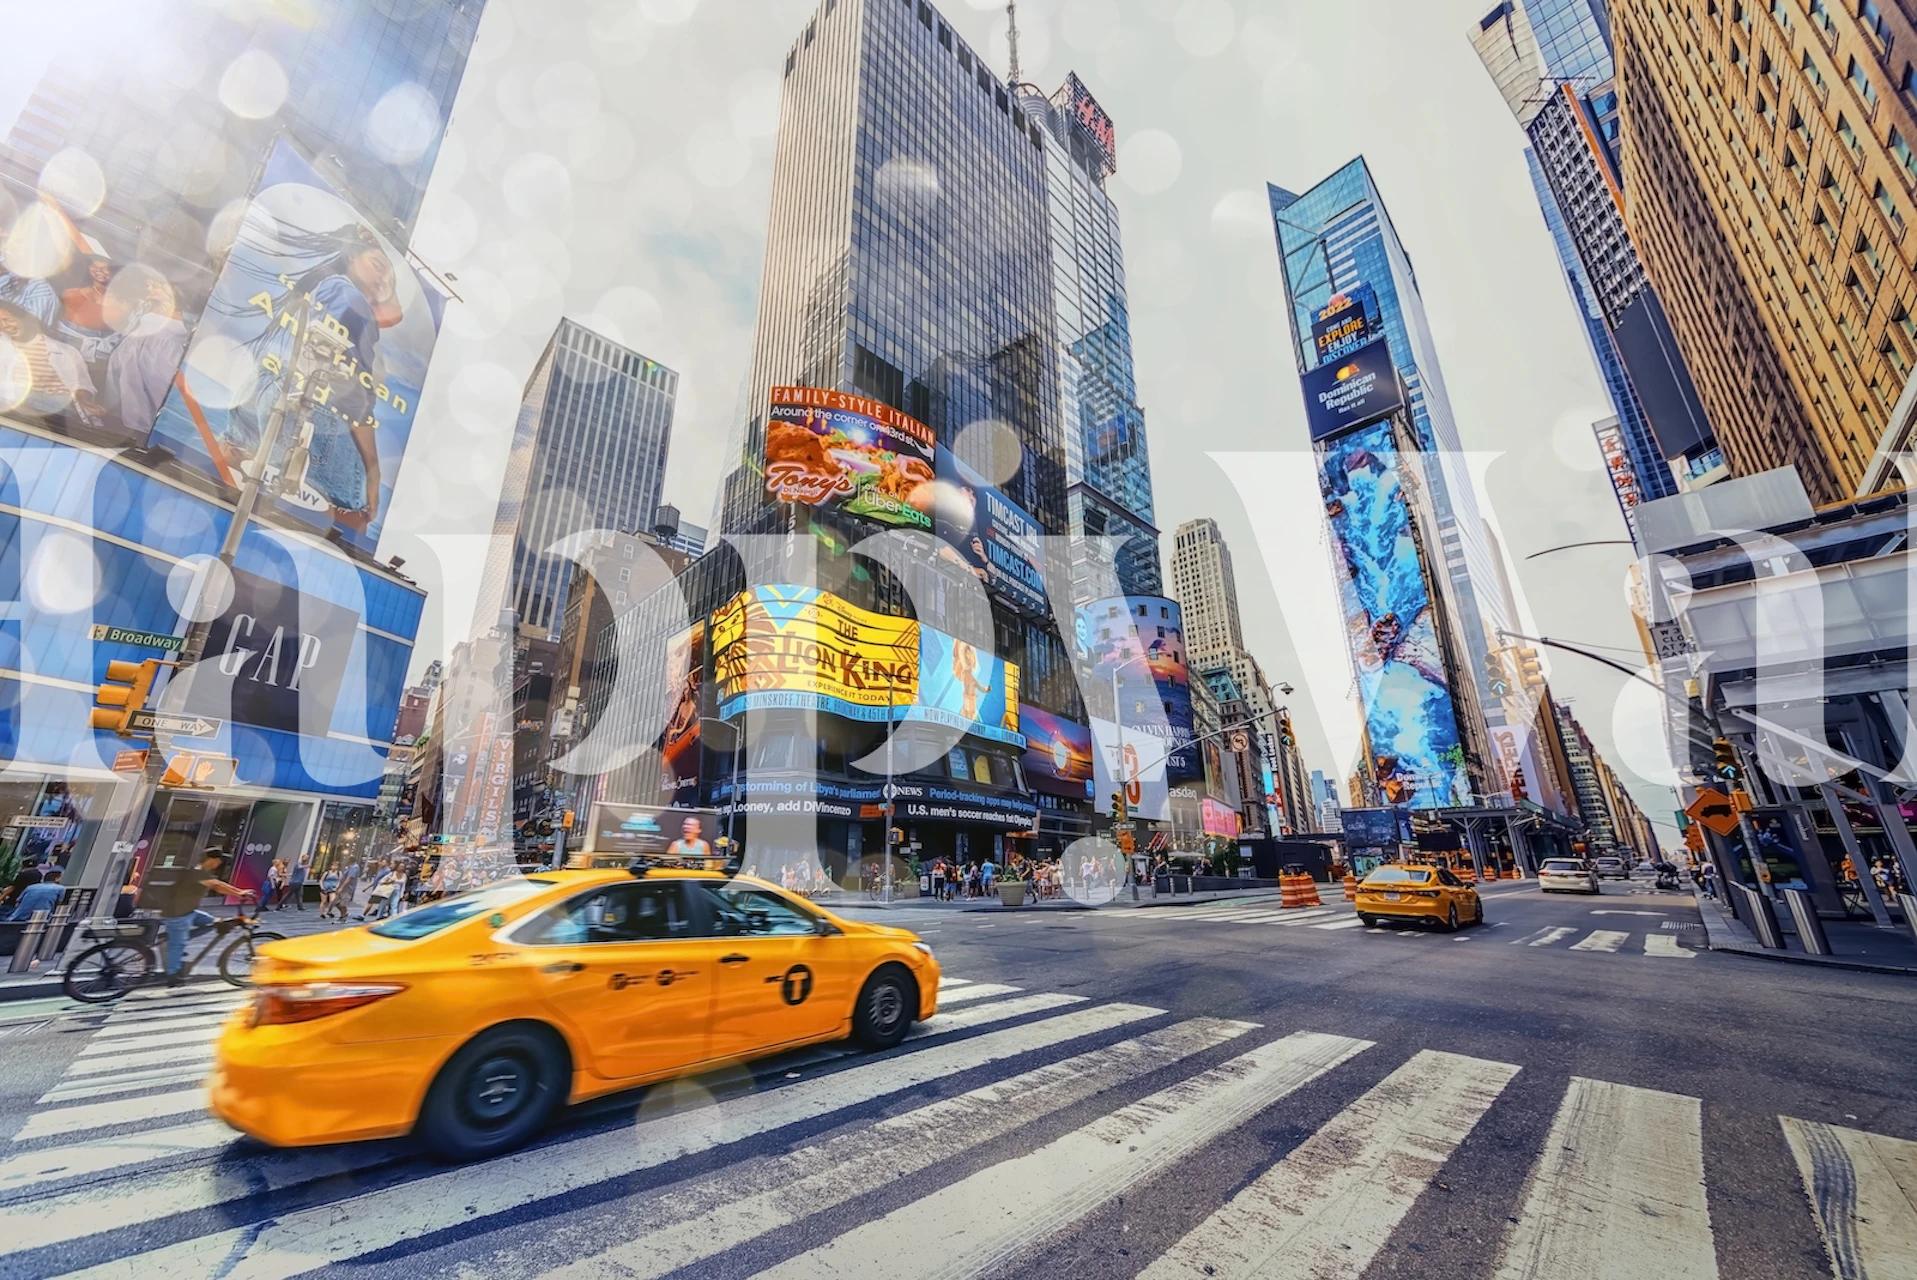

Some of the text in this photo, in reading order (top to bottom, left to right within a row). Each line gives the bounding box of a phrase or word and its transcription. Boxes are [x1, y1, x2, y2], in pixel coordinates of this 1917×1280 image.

[1318, 297, 1353, 321] 2022
[1318, 317, 1364, 347] EXPLORE
[1327, 331, 1358, 354] ENJOY
[1323, 337, 1368, 364] DISCOVER
[1318, 372, 1376, 403] Dominican
[1325, 384, 1374, 410] Republic
[771, 406, 814, 417] Around
[814, 408, 832, 419] the
[833, 413, 867, 427] corner
[774, 388, 934, 444] FAMILY-STYLE ITALIAN
[768, 465, 854, 504] Tony's
[864, 483, 887, 495] ONLY
[985, 491, 1025, 539] TIMCAST
[786, 502, 797, 558] 1500
[986, 538, 1044, 592] TIMCAST.COM
[110, 629, 181, 652] Broadway
[837, 619, 859, 640] THE
[218, 613, 322, 693] GAP
[777, 631, 911, 690] LION KING
[807, 680, 848, 698] EXPERIENCE
[858, 691, 892, 702] TODAY
[752, 692, 793, 708] MINSKOFF
[796, 692, 830, 711] THEATRE,
[866, 708, 885, 721] 45TH
[142, 716, 206, 732] ONE WAY
[740, 780, 792, 794] storming
[795, 781, 808, 792] of
[809, 783, 840, 797] Libya's
[897, 785, 923, 797] NEWS
[929, 787, 985, 805] Period-tracking
[1169, 786, 1198, 801] asdaq
[733, 801, 774, 814] Looney,
[776, 800, 800, 812] add
[803, 801, 852, 816] DiVincenzo
[907, 804, 929, 816] U.S.
[930, 807, 957, 818] men's
[957, 809, 983, 820] soccer
[983, 810, 1005, 824] reaches
